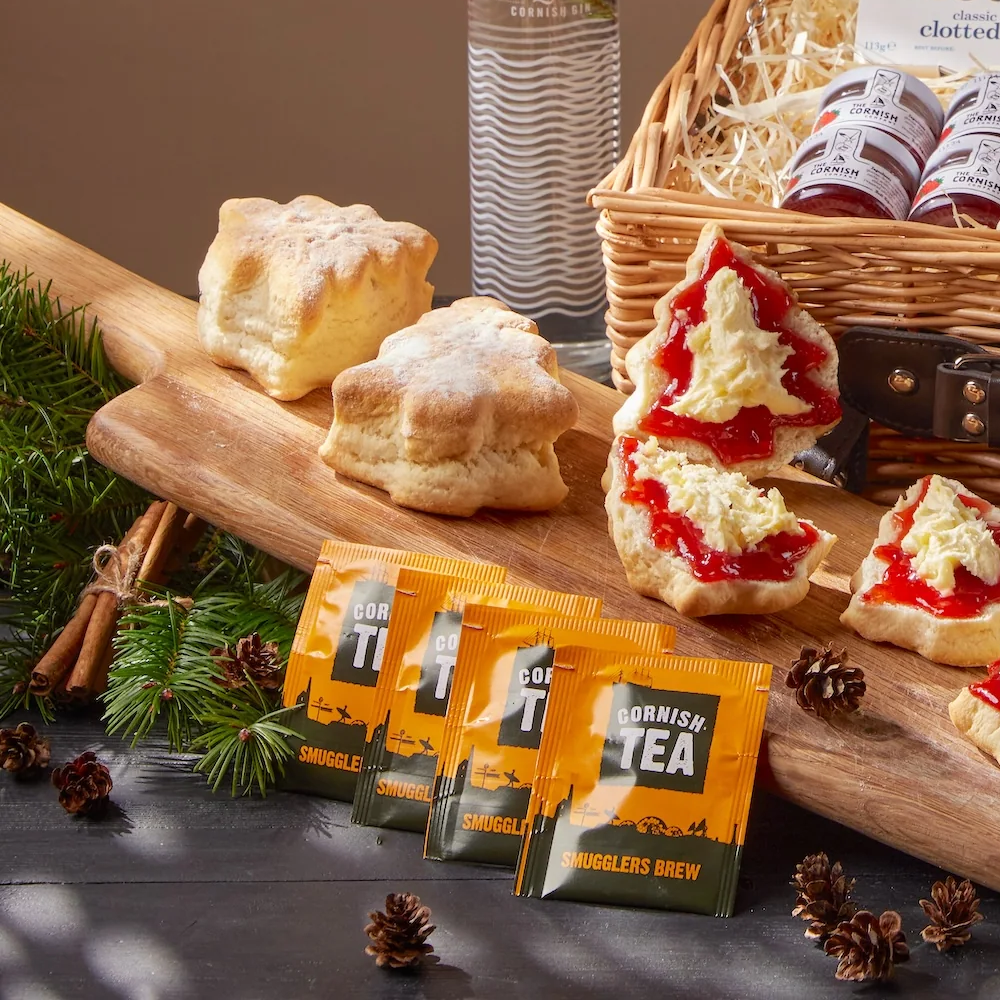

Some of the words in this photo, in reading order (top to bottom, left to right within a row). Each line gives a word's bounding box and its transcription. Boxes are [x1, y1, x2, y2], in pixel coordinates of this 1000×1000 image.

[510, 5, 567, 18] CORNISH
[571, 3, 592, 16] GIN
[953, 10, 998, 22] classic
[919, 21, 1000, 41] clotted
[849, 107, 899, 123] CORNISH
[810, 166, 860, 177] CORNISH
[520, 688, 549, 732] T
[617, 705, 706, 733] CORNISH
[619, 727, 695, 776] TEA
[561, 851, 651, 875] SMUGGLERS
[654, 859, 702, 881] BREW
